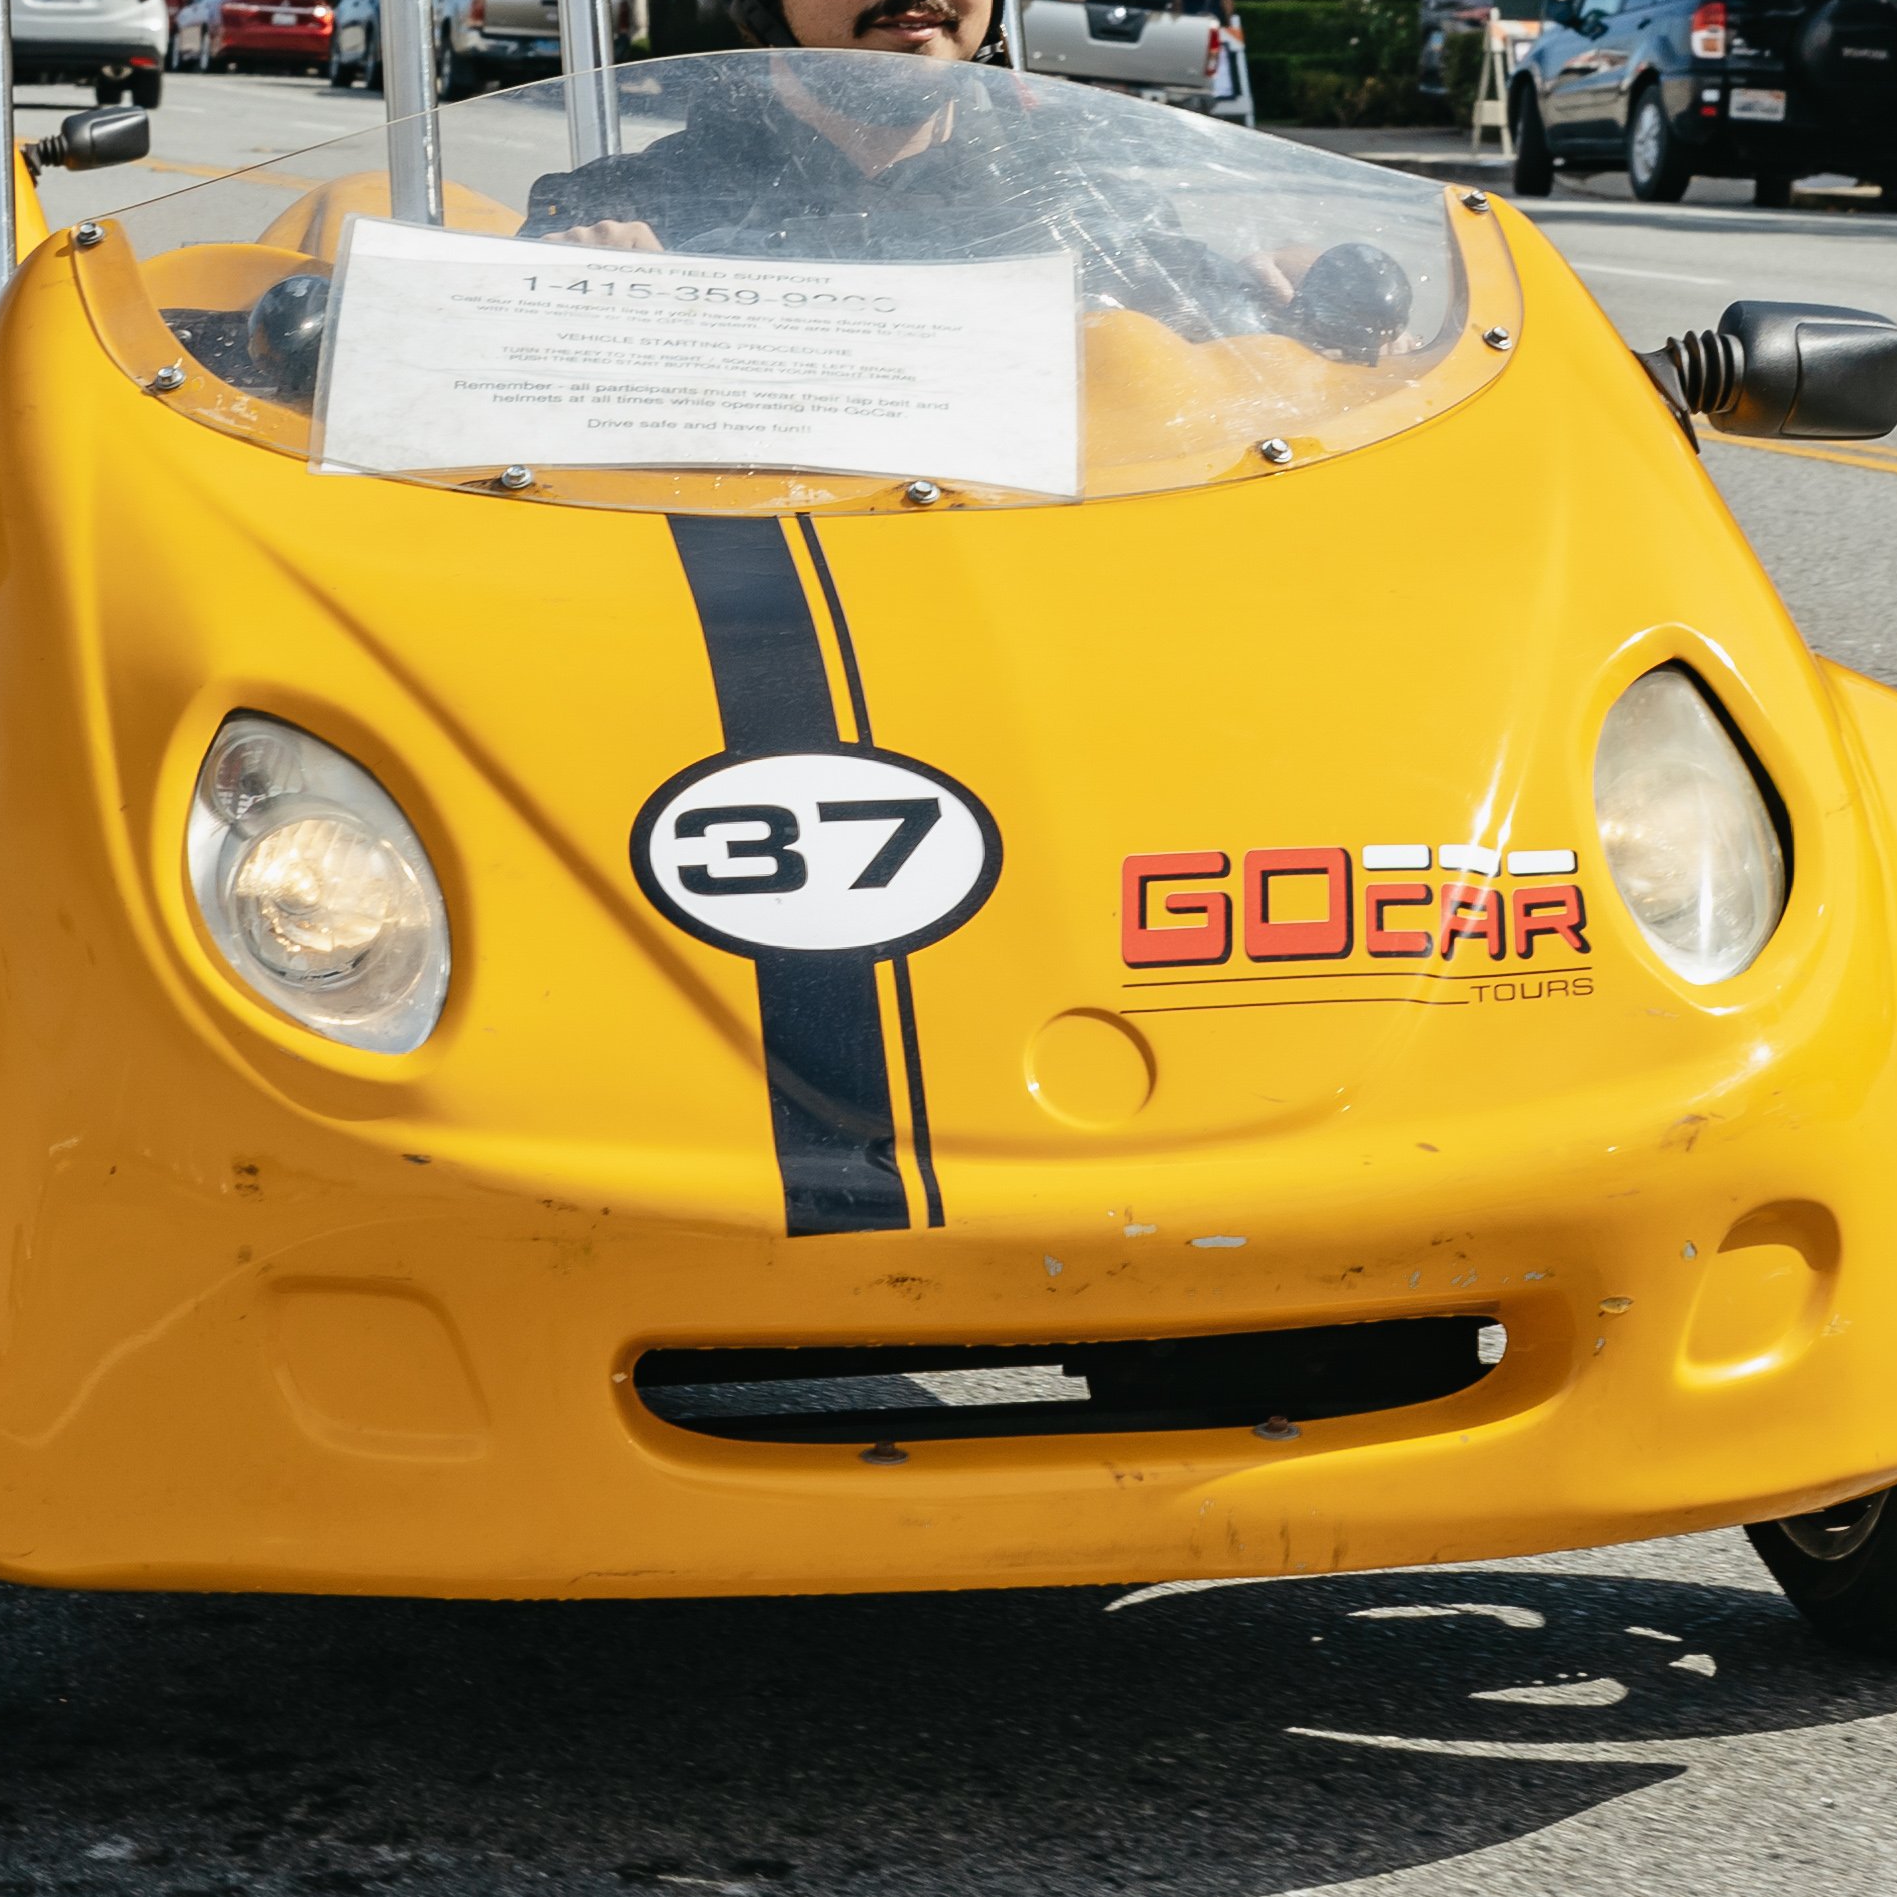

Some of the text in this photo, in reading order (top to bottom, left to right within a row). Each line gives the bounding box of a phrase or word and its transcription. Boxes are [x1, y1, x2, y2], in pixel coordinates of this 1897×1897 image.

[586, 263, 831, 284] GOCAR FIELD SUPPORT
[451, 294, 481, 303] Call
[556, 302, 614, 312] support
[621, 306, 648, 314] line
[670, 309, 695, 318] you
[703, 311, 740, 320] have
[747, 315, 773, 323] any
[780, 316, 830, 325] issues
[836, 318, 885, 329] during
[894, 322, 925, 331] your
[656, 316, 694, 325] GPS
[503, 345, 539, 354] TURN
[659, 353, 701, 362] RIGHT
[722, 357, 783, 366] SQUEEZE
[556, 332, 852, 357] VEHICLE STARTING PROCEDURE
[508, 353, 547, 362] PUSH
[615, 359, 658, 367] START
[664, 361, 720, 370] BUTTON
[723, 364, 773, 373] UNDER
[779, 367, 815, 375] YOUR
[820, 370, 862, 378] RIGHT
[453, 379, 552, 392] Remember
[569, 382, 589, 391] all
[594, 383, 697, 396] participants
[703, 388, 745, 397] must
[753, 391, 794, 400] wear
[802, 392, 839, 402] their
[845, 395, 872, 406] lap
[878, 397, 909, 407] belt
[916, 400, 949, 410] and
[492, 392, 562, 403] helmets
[568, 394, 584, 403] at
[591, 394, 610, 403] all
[615, 395, 663, 405] times
[670, 397, 715, 407] while
[720, 400, 804, 413] operating
[810, 404, 837, 413] the
[587, 418, 633, 429] Drive
[639, 418, 676, 429] safe
[683, 420, 716, 430] and
[723, 421, 766, 432] have
[672, 796, 942, 897] 37
[1121, 845, 1592, 969] GOCAR
[1469, 976, 1594, 1005] TOURS
